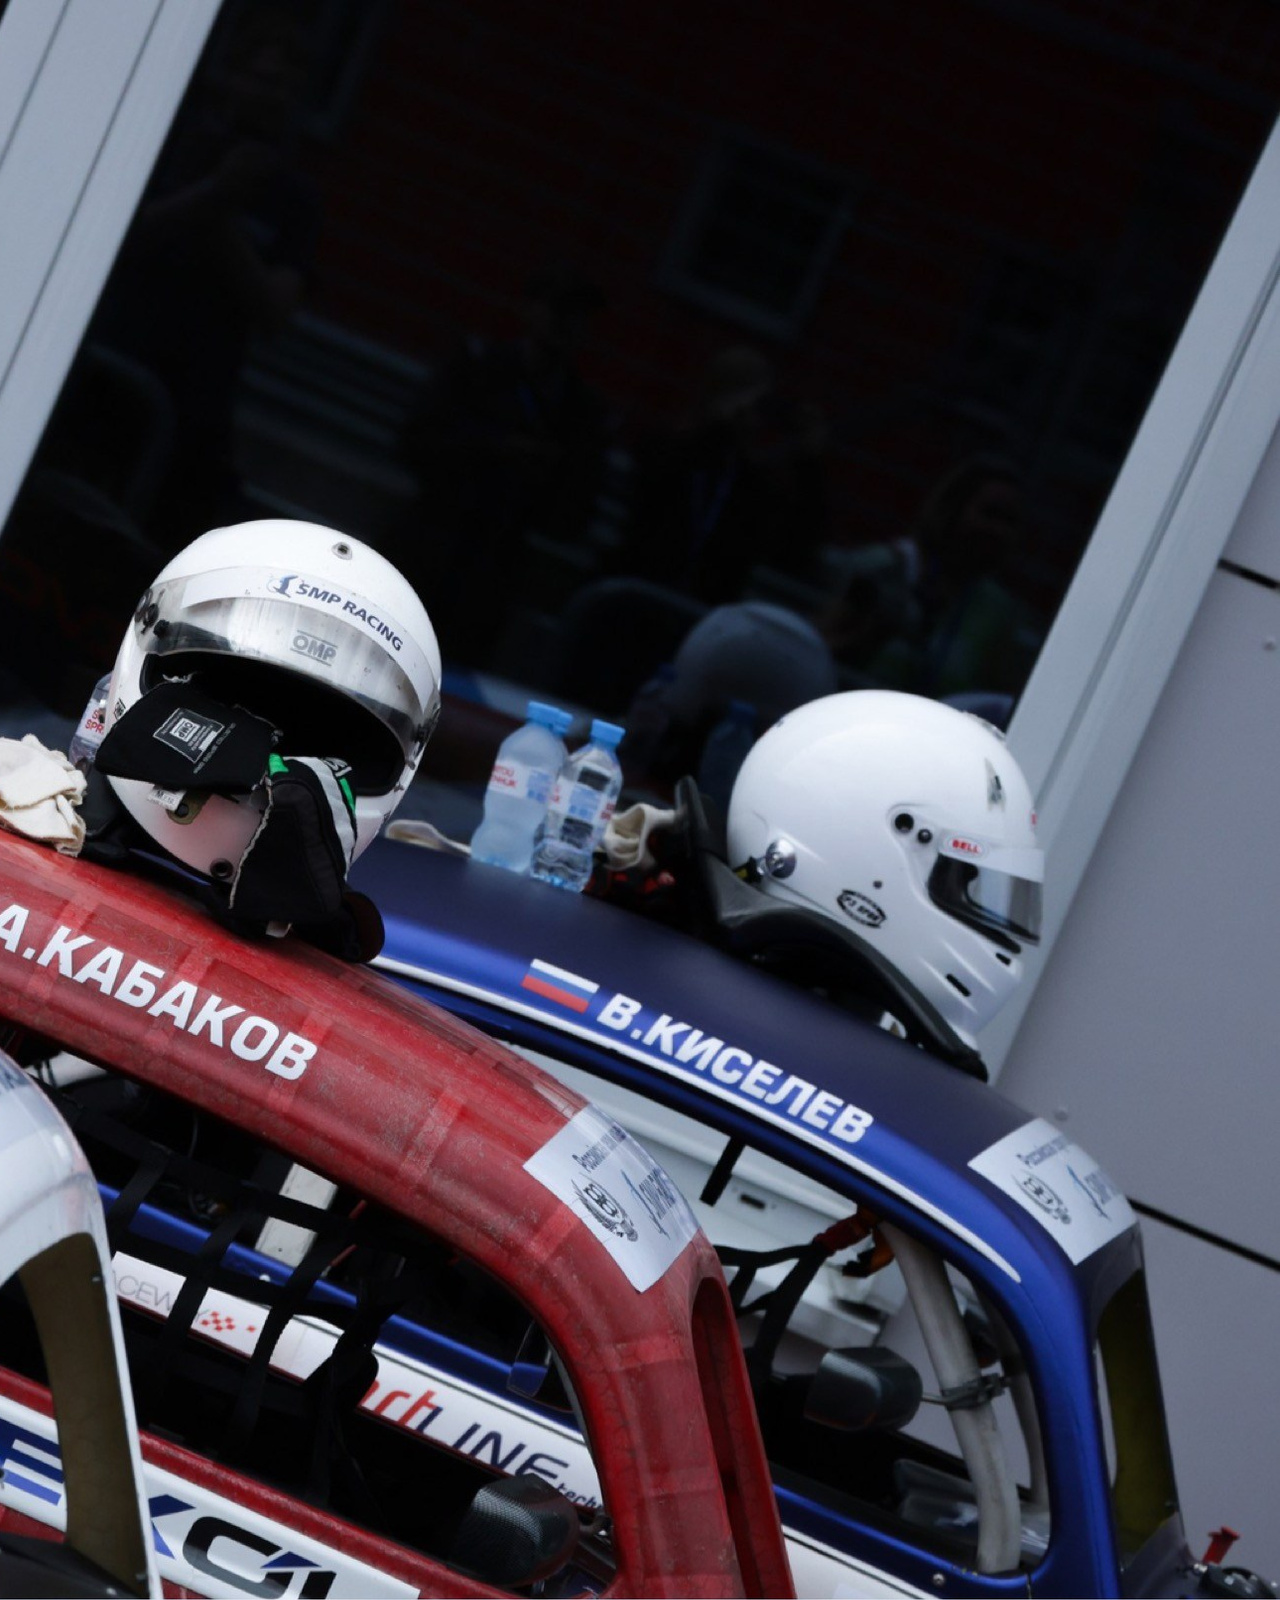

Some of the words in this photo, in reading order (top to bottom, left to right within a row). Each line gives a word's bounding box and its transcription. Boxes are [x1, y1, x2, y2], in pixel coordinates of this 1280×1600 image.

[295, 583, 342, 604] SMP
[341, 600, 404, 652] RACING
[292, 634, 338, 662] OMP
[951, 838, 981, 854] BELL
[596, 993, 874, 1143] В.КИСЕЛЕВ
